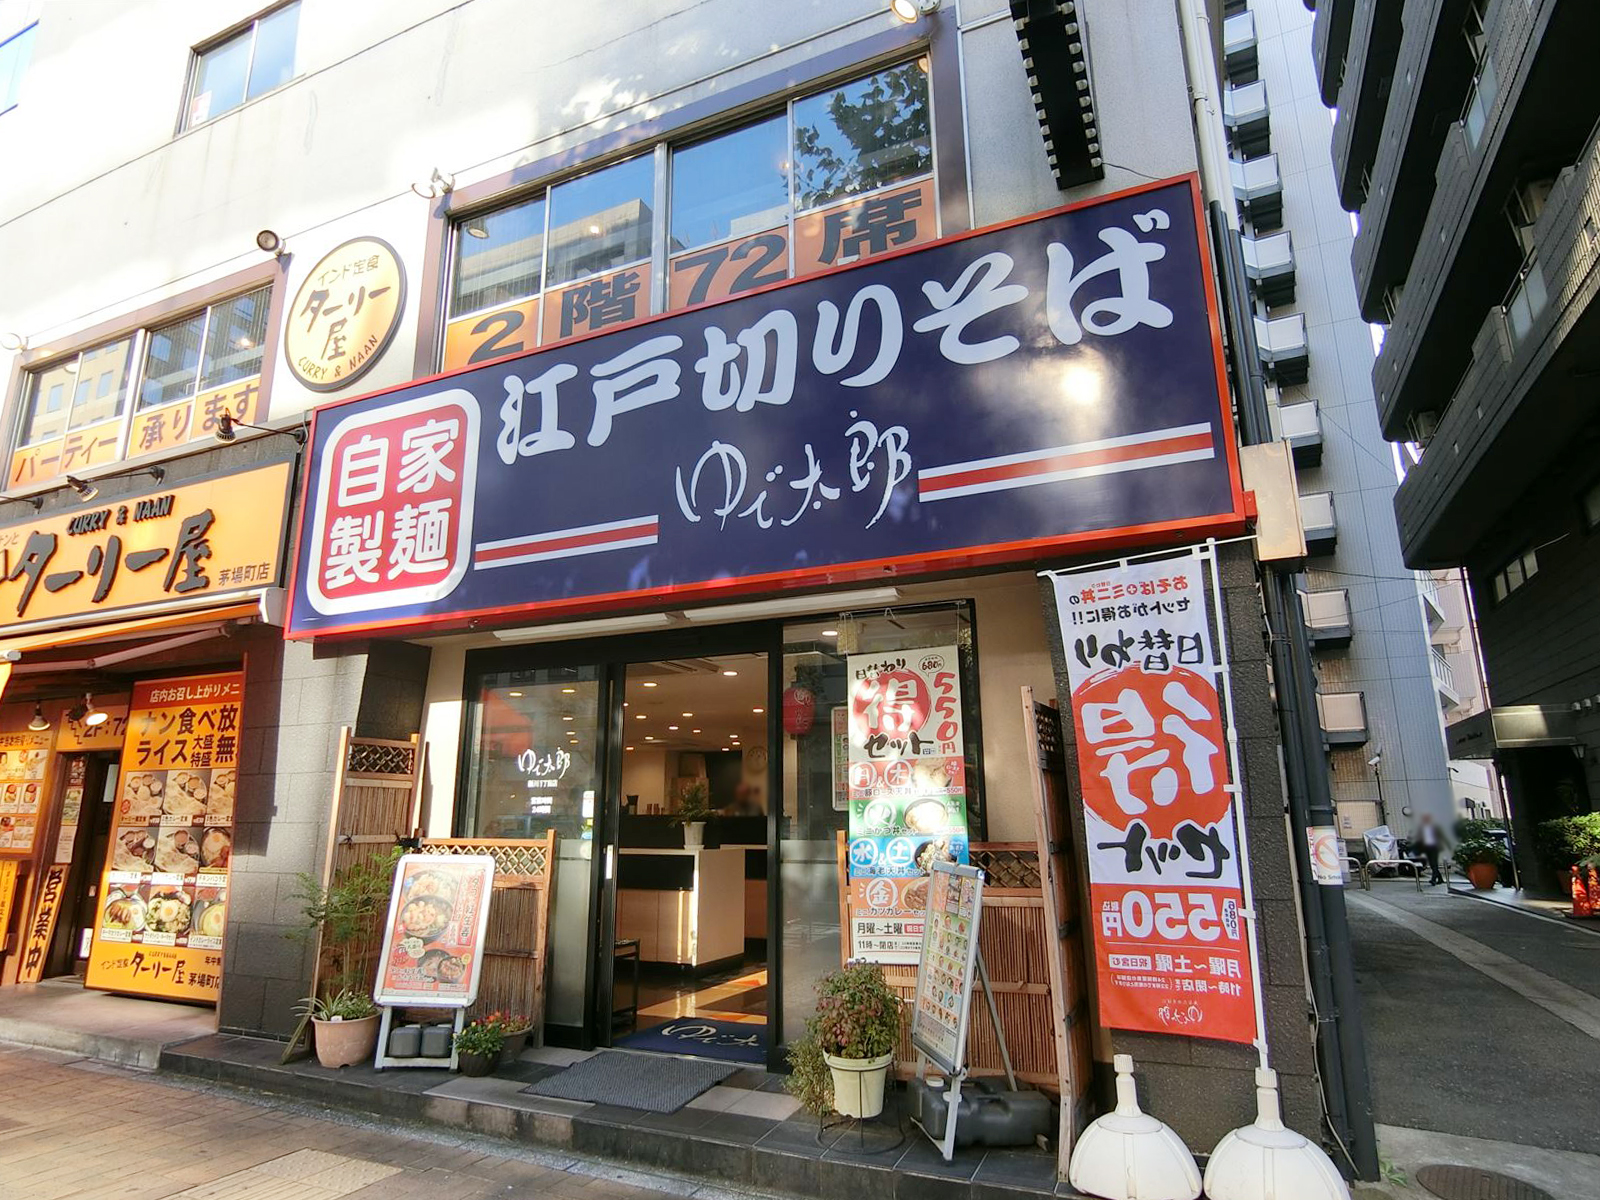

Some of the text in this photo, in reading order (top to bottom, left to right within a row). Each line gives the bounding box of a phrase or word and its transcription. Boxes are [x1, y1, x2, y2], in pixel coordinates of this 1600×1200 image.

[317, 254, 381, 284] インド定食
[497, 208, 1173, 465] 江戸切りそば
[297, 335, 379, 381] CURRY & NAAN
[676, 410, 912, 531] ゆで太郎
[66, 495, 175, 537] CURRY & NAAN
[9, 508, 215, 618] ターリー屋
[218, 562, 270, 586] 茅場町店
[136, 739, 188, 766] ライス
[192, 734, 215, 751] 大盛
[864, 731, 934, 759] セット
[26, 868, 63, 979] 営業中
[130, 951, 186, 984] ターリー屋
